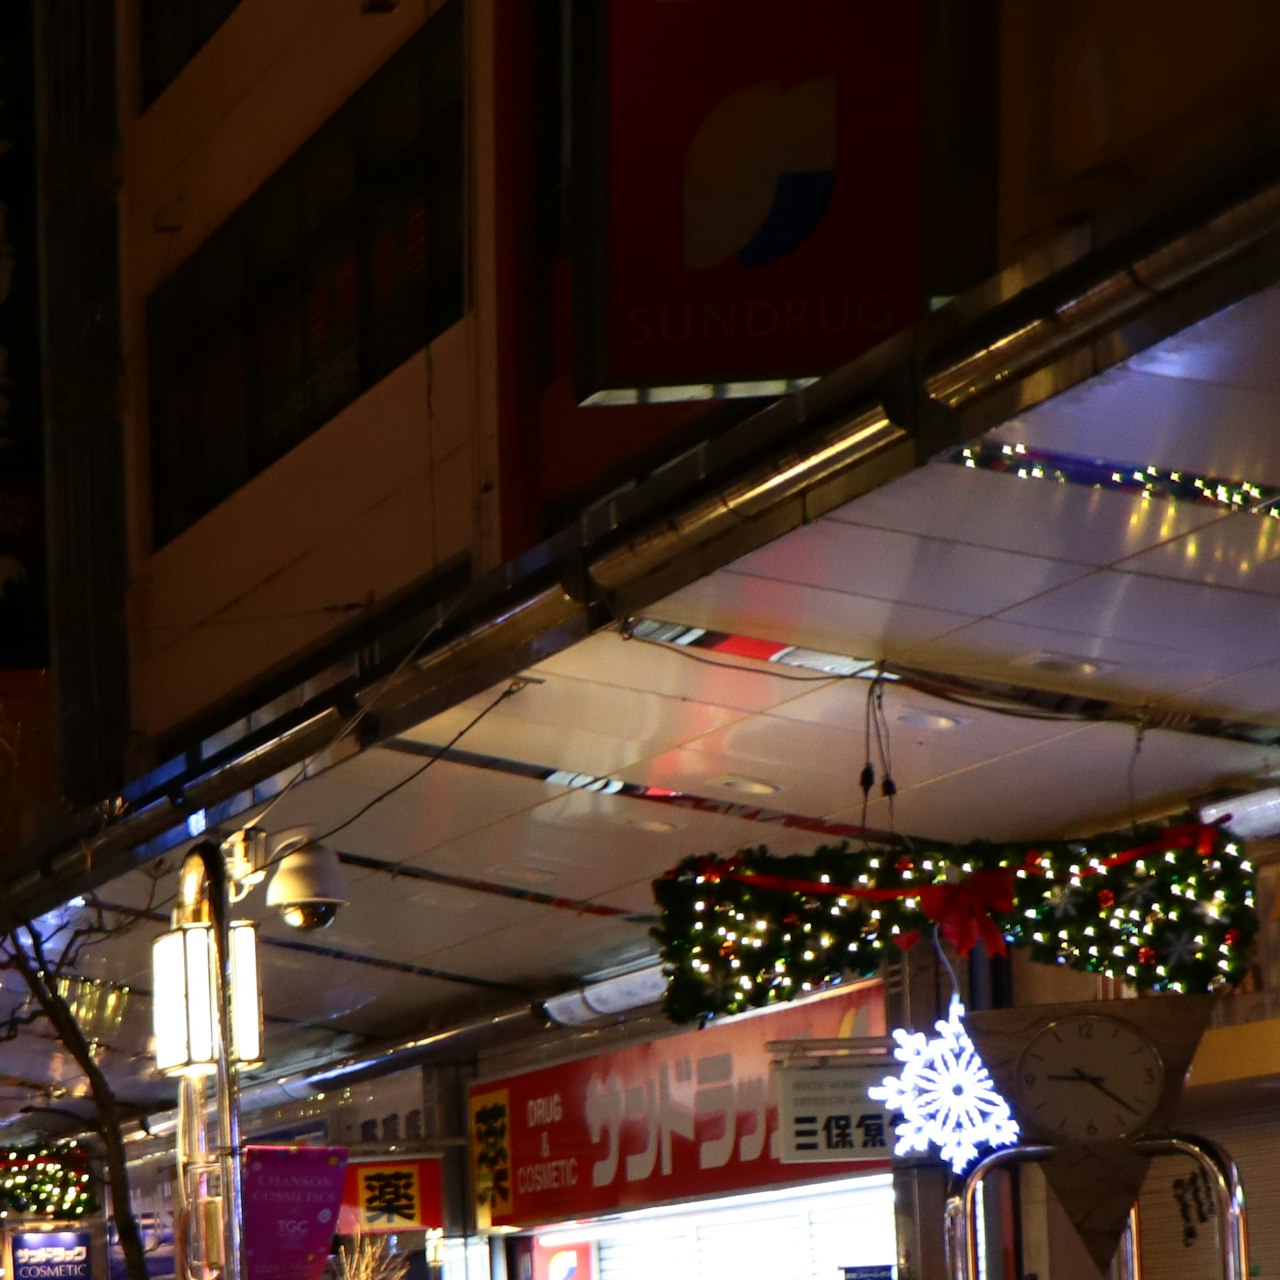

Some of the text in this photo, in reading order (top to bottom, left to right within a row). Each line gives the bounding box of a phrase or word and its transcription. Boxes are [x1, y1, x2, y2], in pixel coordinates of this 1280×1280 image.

[623, 291, 896, 346] SUNDRUG
[526, 1093, 563, 1128] DRUG
[585, 1052, 785, 1188] サンドラッ
[794, 1113, 905, 1149] 三保原
[476, 1101, 509, 1208] 薬
[258, 1175, 332, 1187] CHANSON
[517, 1158, 578, 1194] COSMETIC
[253, 1190, 336, 1201] COSMETICS
[364, 1170, 416, 1224] 薬
[277, 1219, 309, 1233] TGC
[16, 1246, 87, 1264] サンドラッグ
[20, 1264, 87, 1278] COSMETIC
